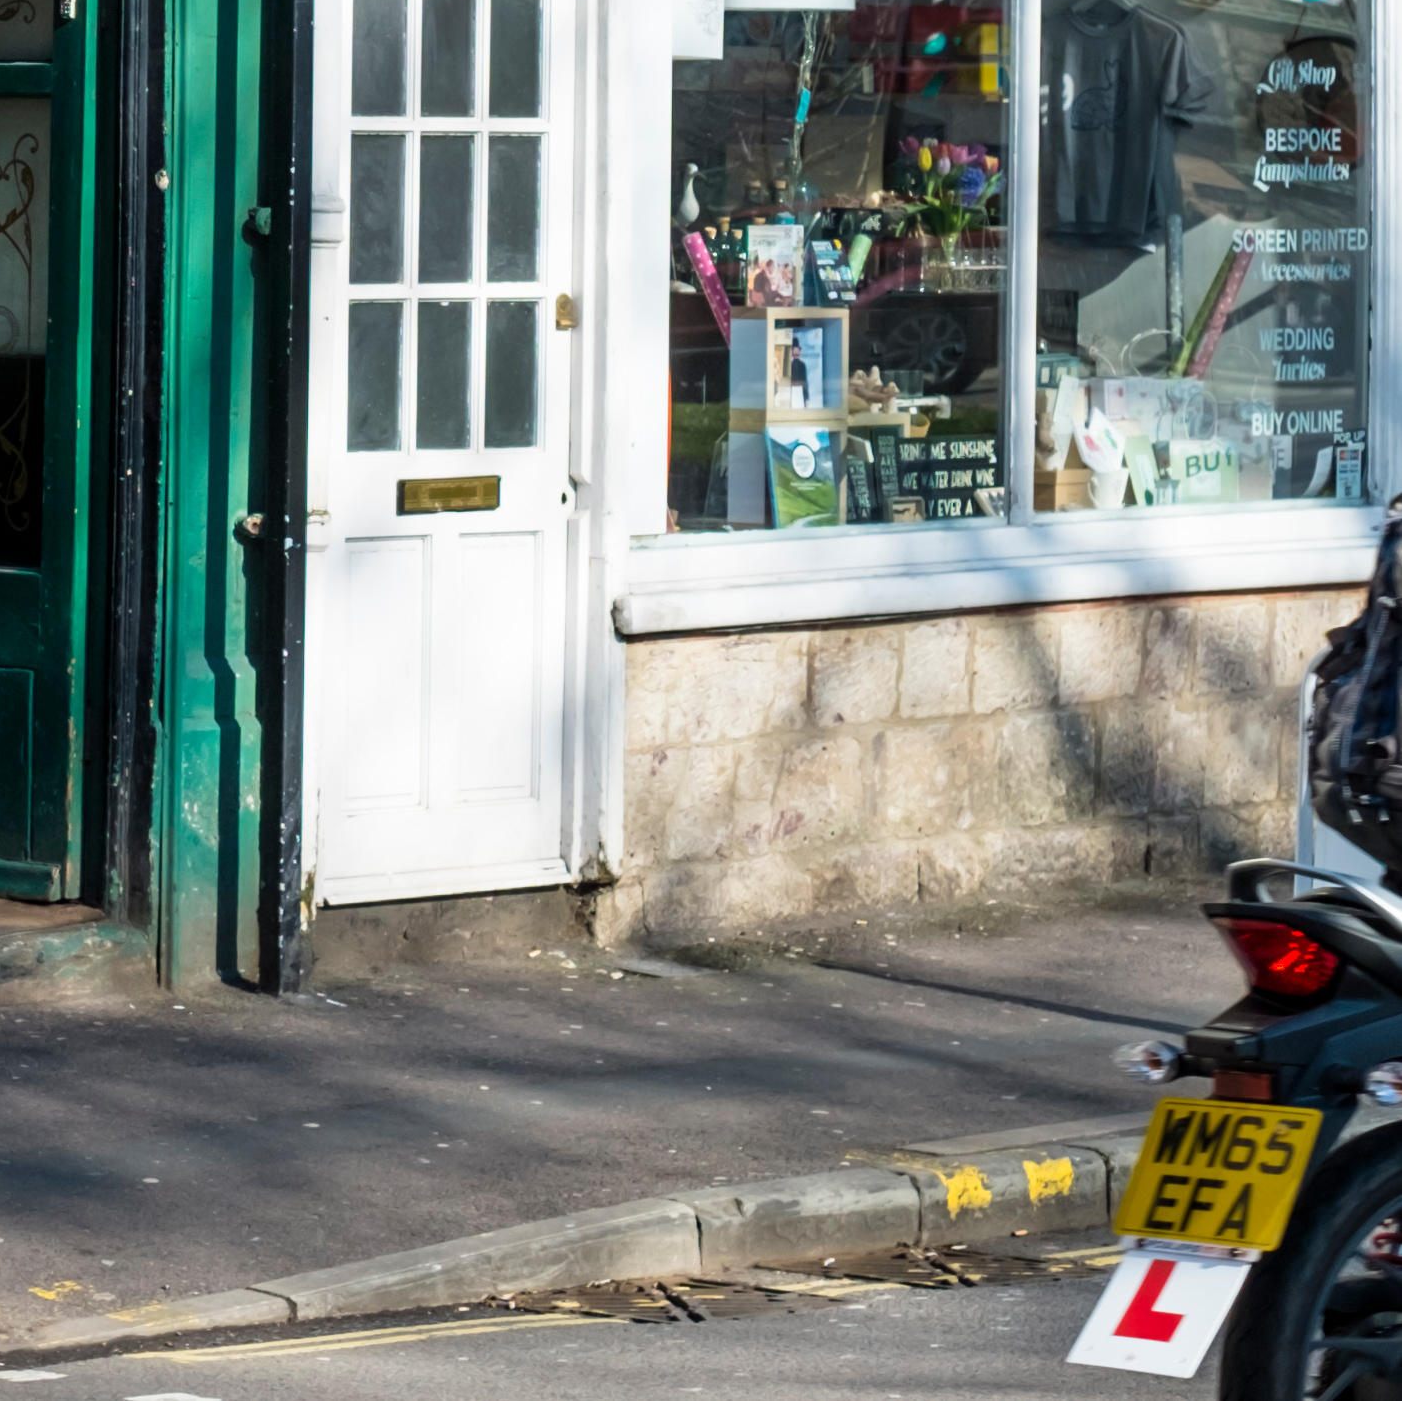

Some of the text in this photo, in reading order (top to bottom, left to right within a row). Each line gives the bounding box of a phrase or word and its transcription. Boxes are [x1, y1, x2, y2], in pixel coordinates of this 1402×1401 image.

[1298, 59, 1337, 92] Shop
[1265, 127, 1342, 152] BESPOKE
[1252, 155, 1350, 192] Lampshades
[1232, 228, 1369, 253] SCREEN PRINTED
[1258, 327, 1335, 352] WEDDING
[1251, 409, 1344, 437] BUY ONLINE
[930, 442, 947, 460] ME
[950, 439, 996, 460] SUNSHINE
[1152, 1107, 1306, 1176] WM65
[1143, 1174, 1254, 1240] EFA
[1112, 1259, 1187, 1343] L
